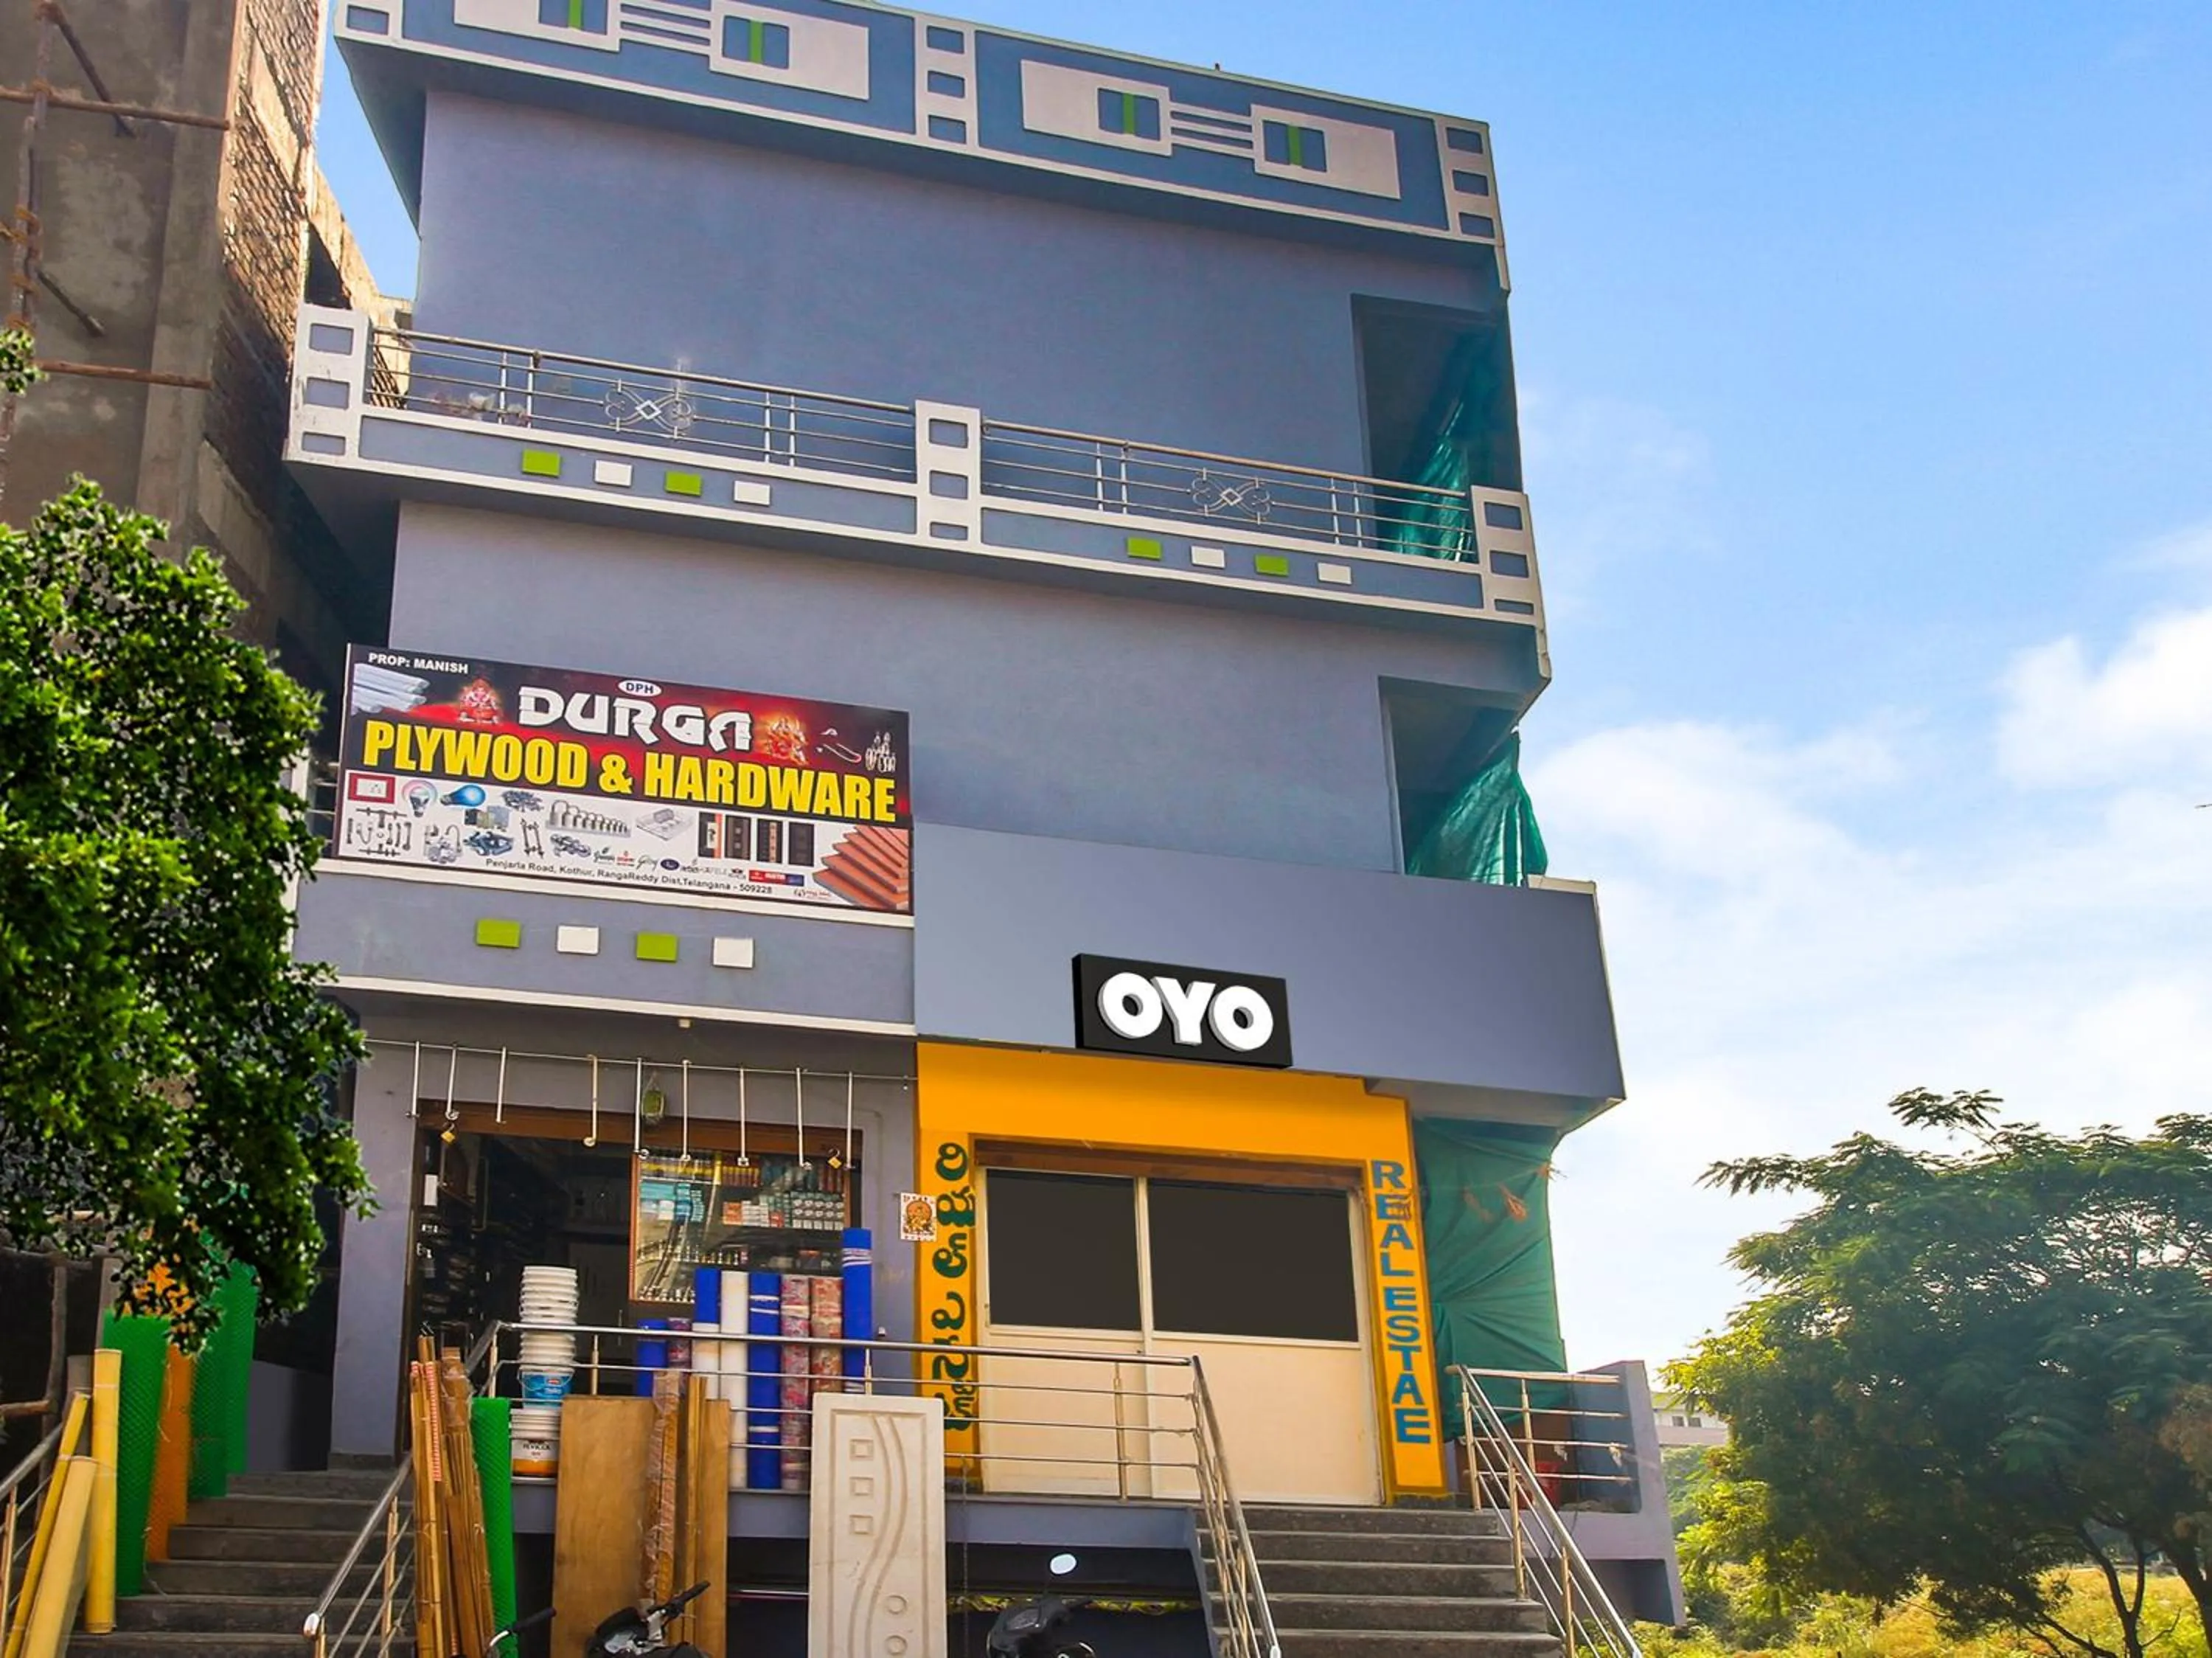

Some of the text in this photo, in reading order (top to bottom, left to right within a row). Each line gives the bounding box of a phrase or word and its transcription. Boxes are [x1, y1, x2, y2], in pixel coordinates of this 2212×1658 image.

[369, 652, 469, 675] PROP: MANISH
[625, 682, 655, 695] DPH
[518, 686, 752, 752] DURGA
[363, 719, 897, 822] PLYWOOD & HARDWARE
[1097, 971, 1274, 1052] OYO
[1371, 1159, 1431, 1445] REAL ESTAE
